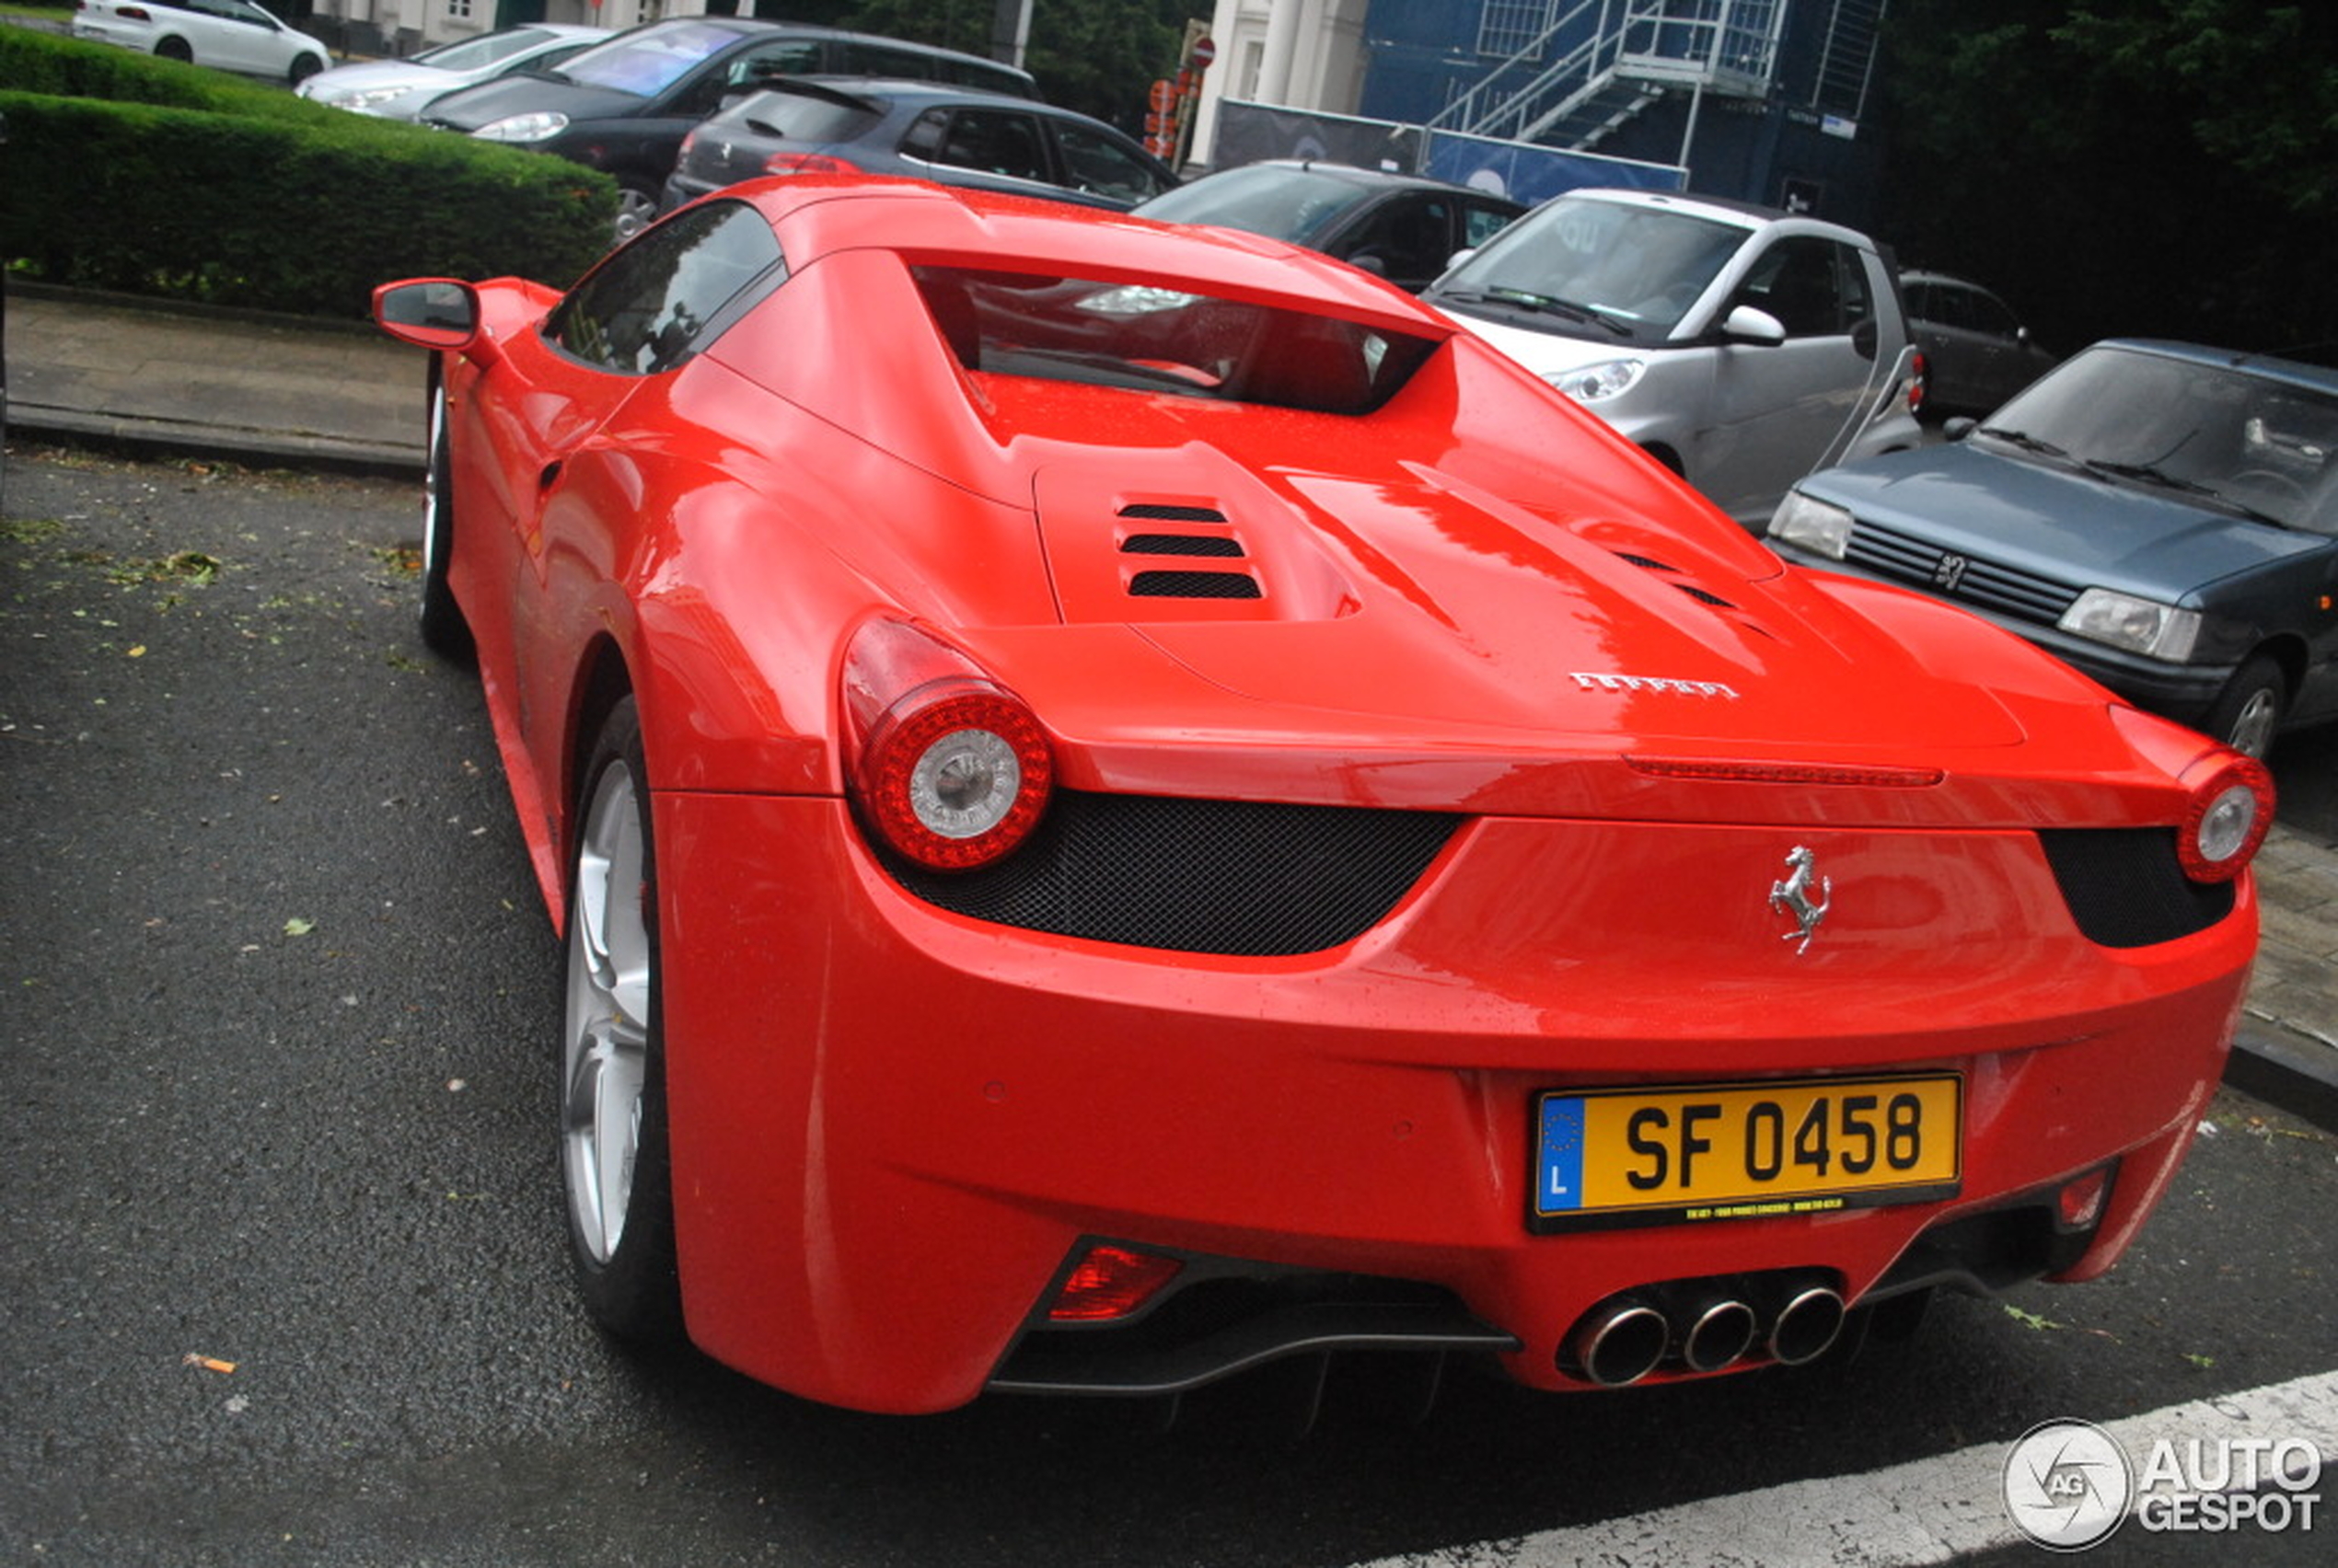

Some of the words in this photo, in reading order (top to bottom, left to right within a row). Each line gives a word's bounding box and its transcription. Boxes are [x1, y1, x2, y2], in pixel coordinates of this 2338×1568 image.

[1626, 1103, 1722, 1190] SF
[1744, 1092, 1922, 1182] 0458
[1551, 1165, 1568, 1194] L
